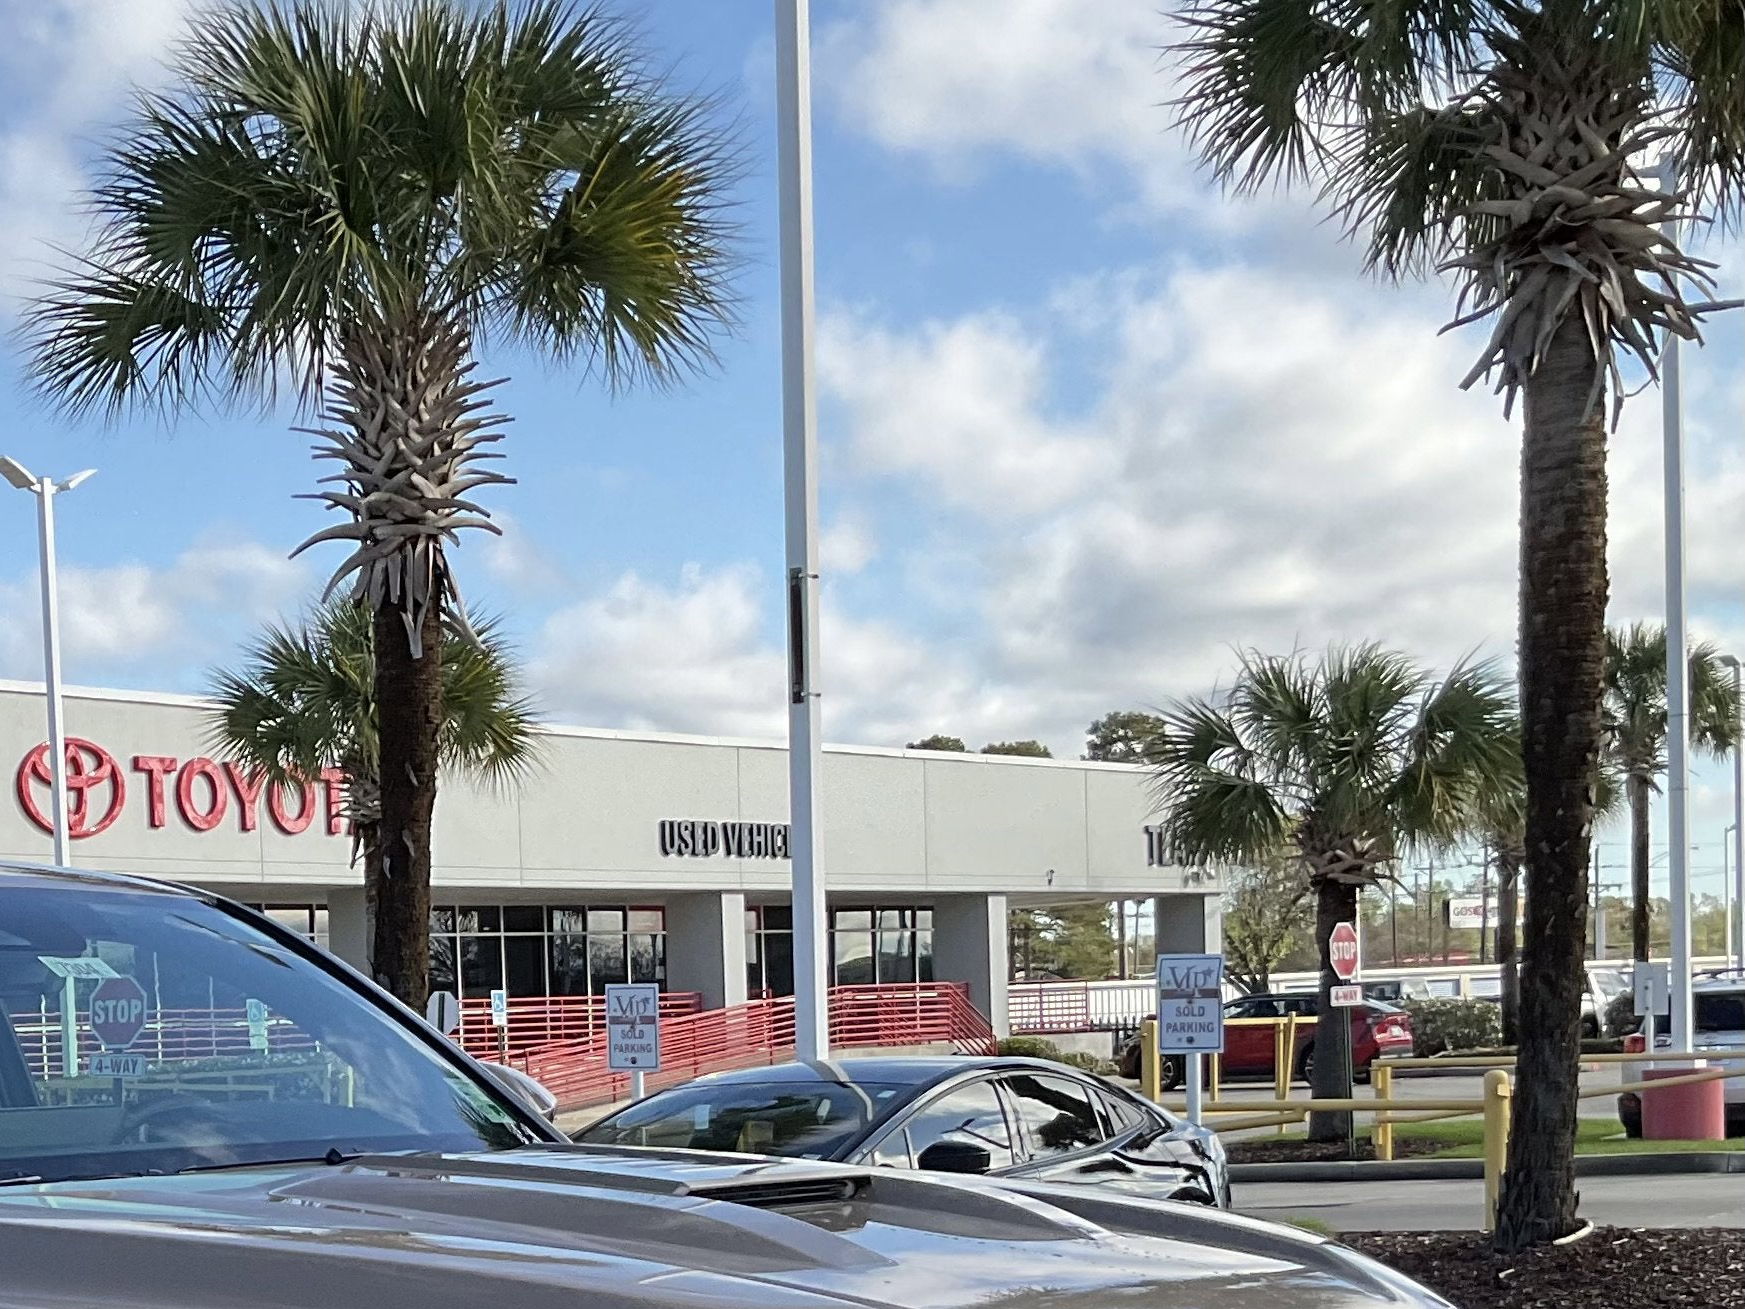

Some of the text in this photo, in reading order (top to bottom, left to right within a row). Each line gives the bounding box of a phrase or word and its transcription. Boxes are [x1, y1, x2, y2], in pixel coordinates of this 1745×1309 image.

[132, 755, 354, 836] TOYOT
[659, 820, 792, 860] USED VEHIC
[1333, 941, 1356, 960] STOP
[1334, 990, 1358, 1003] 4-WAY
[94, 999, 142, 1024] STOP
[1175, 1006, 1206, 1017] SOLD
[620, 1029, 645, 1040] SOLD
[1165, 1022, 1215, 1033] PARKING
[614, 1043, 653, 1054] PARKING
[94, 1058, 139, 1075] 4-WAY
